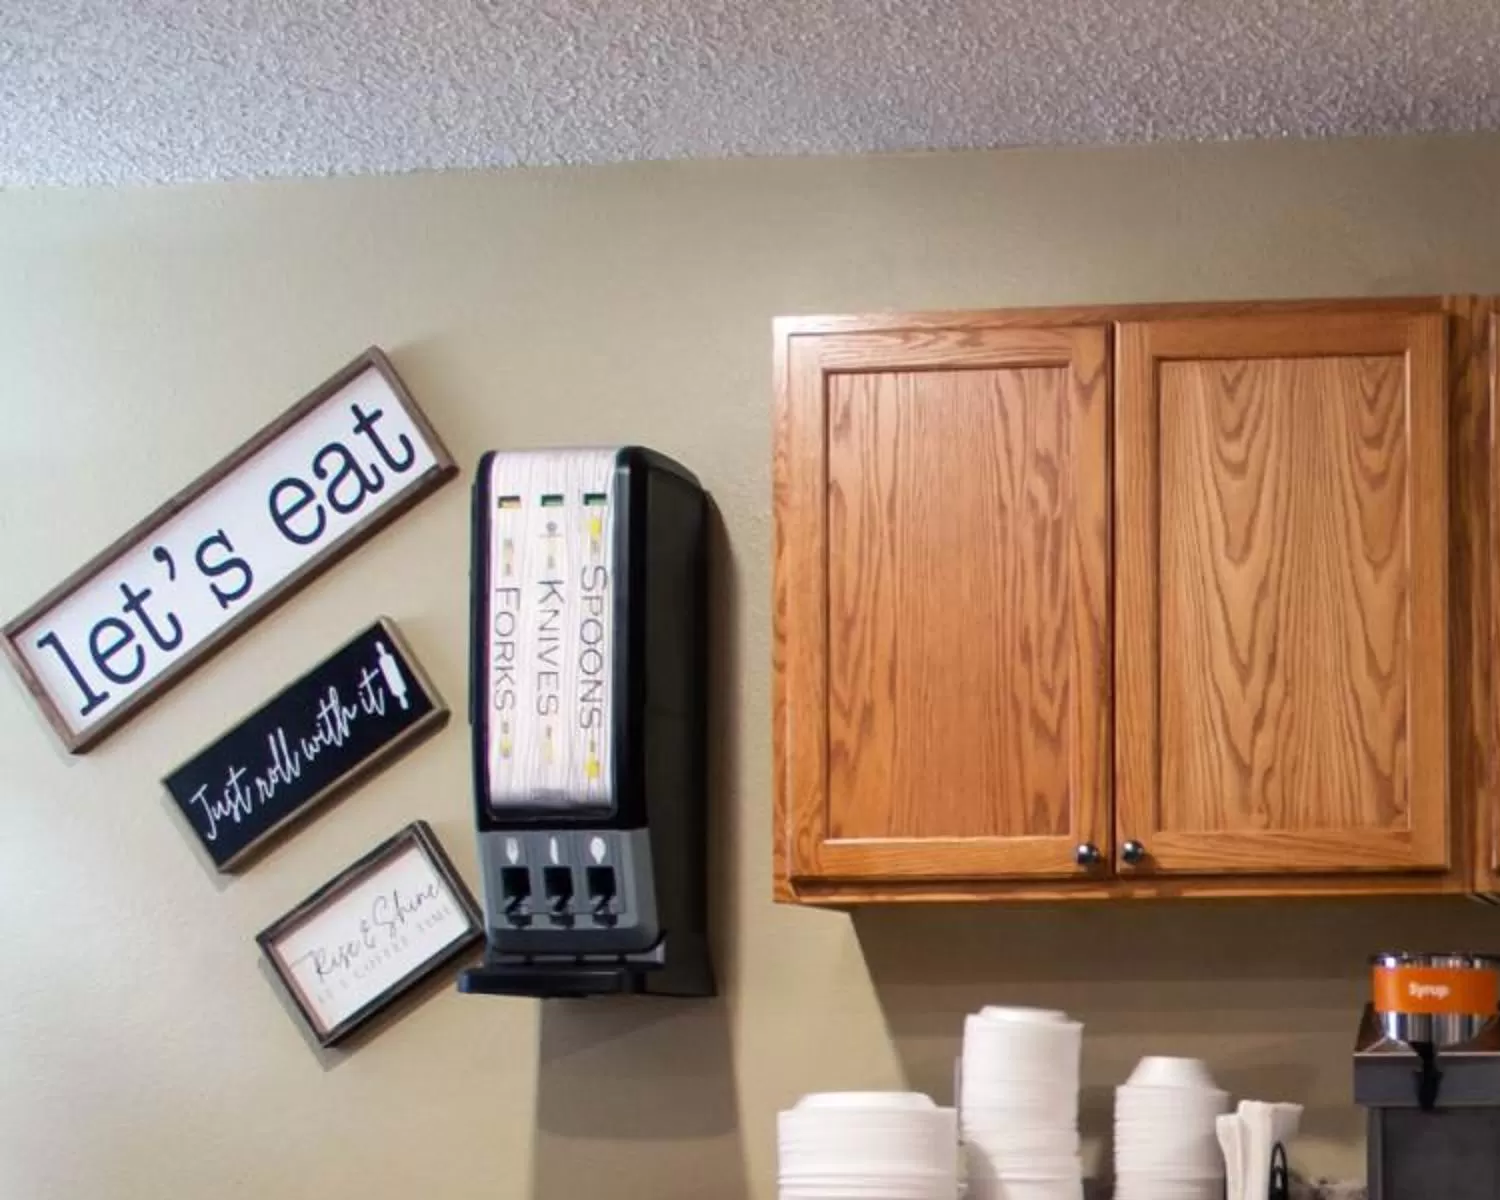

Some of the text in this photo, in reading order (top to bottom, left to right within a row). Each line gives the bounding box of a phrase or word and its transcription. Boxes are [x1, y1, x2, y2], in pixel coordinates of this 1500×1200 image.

[36, 402, 417, 717] let's eat
[494, 587, 521, 712] FORKS
[536, 579, 565, 717] KNIVES
[579, 564, 608, 730] SPOONS
[190, 666, 386, 841] Just roll with it
[372, 880, 440, 940] Shine
[1408, 981, 1450, 1000] Syrup
